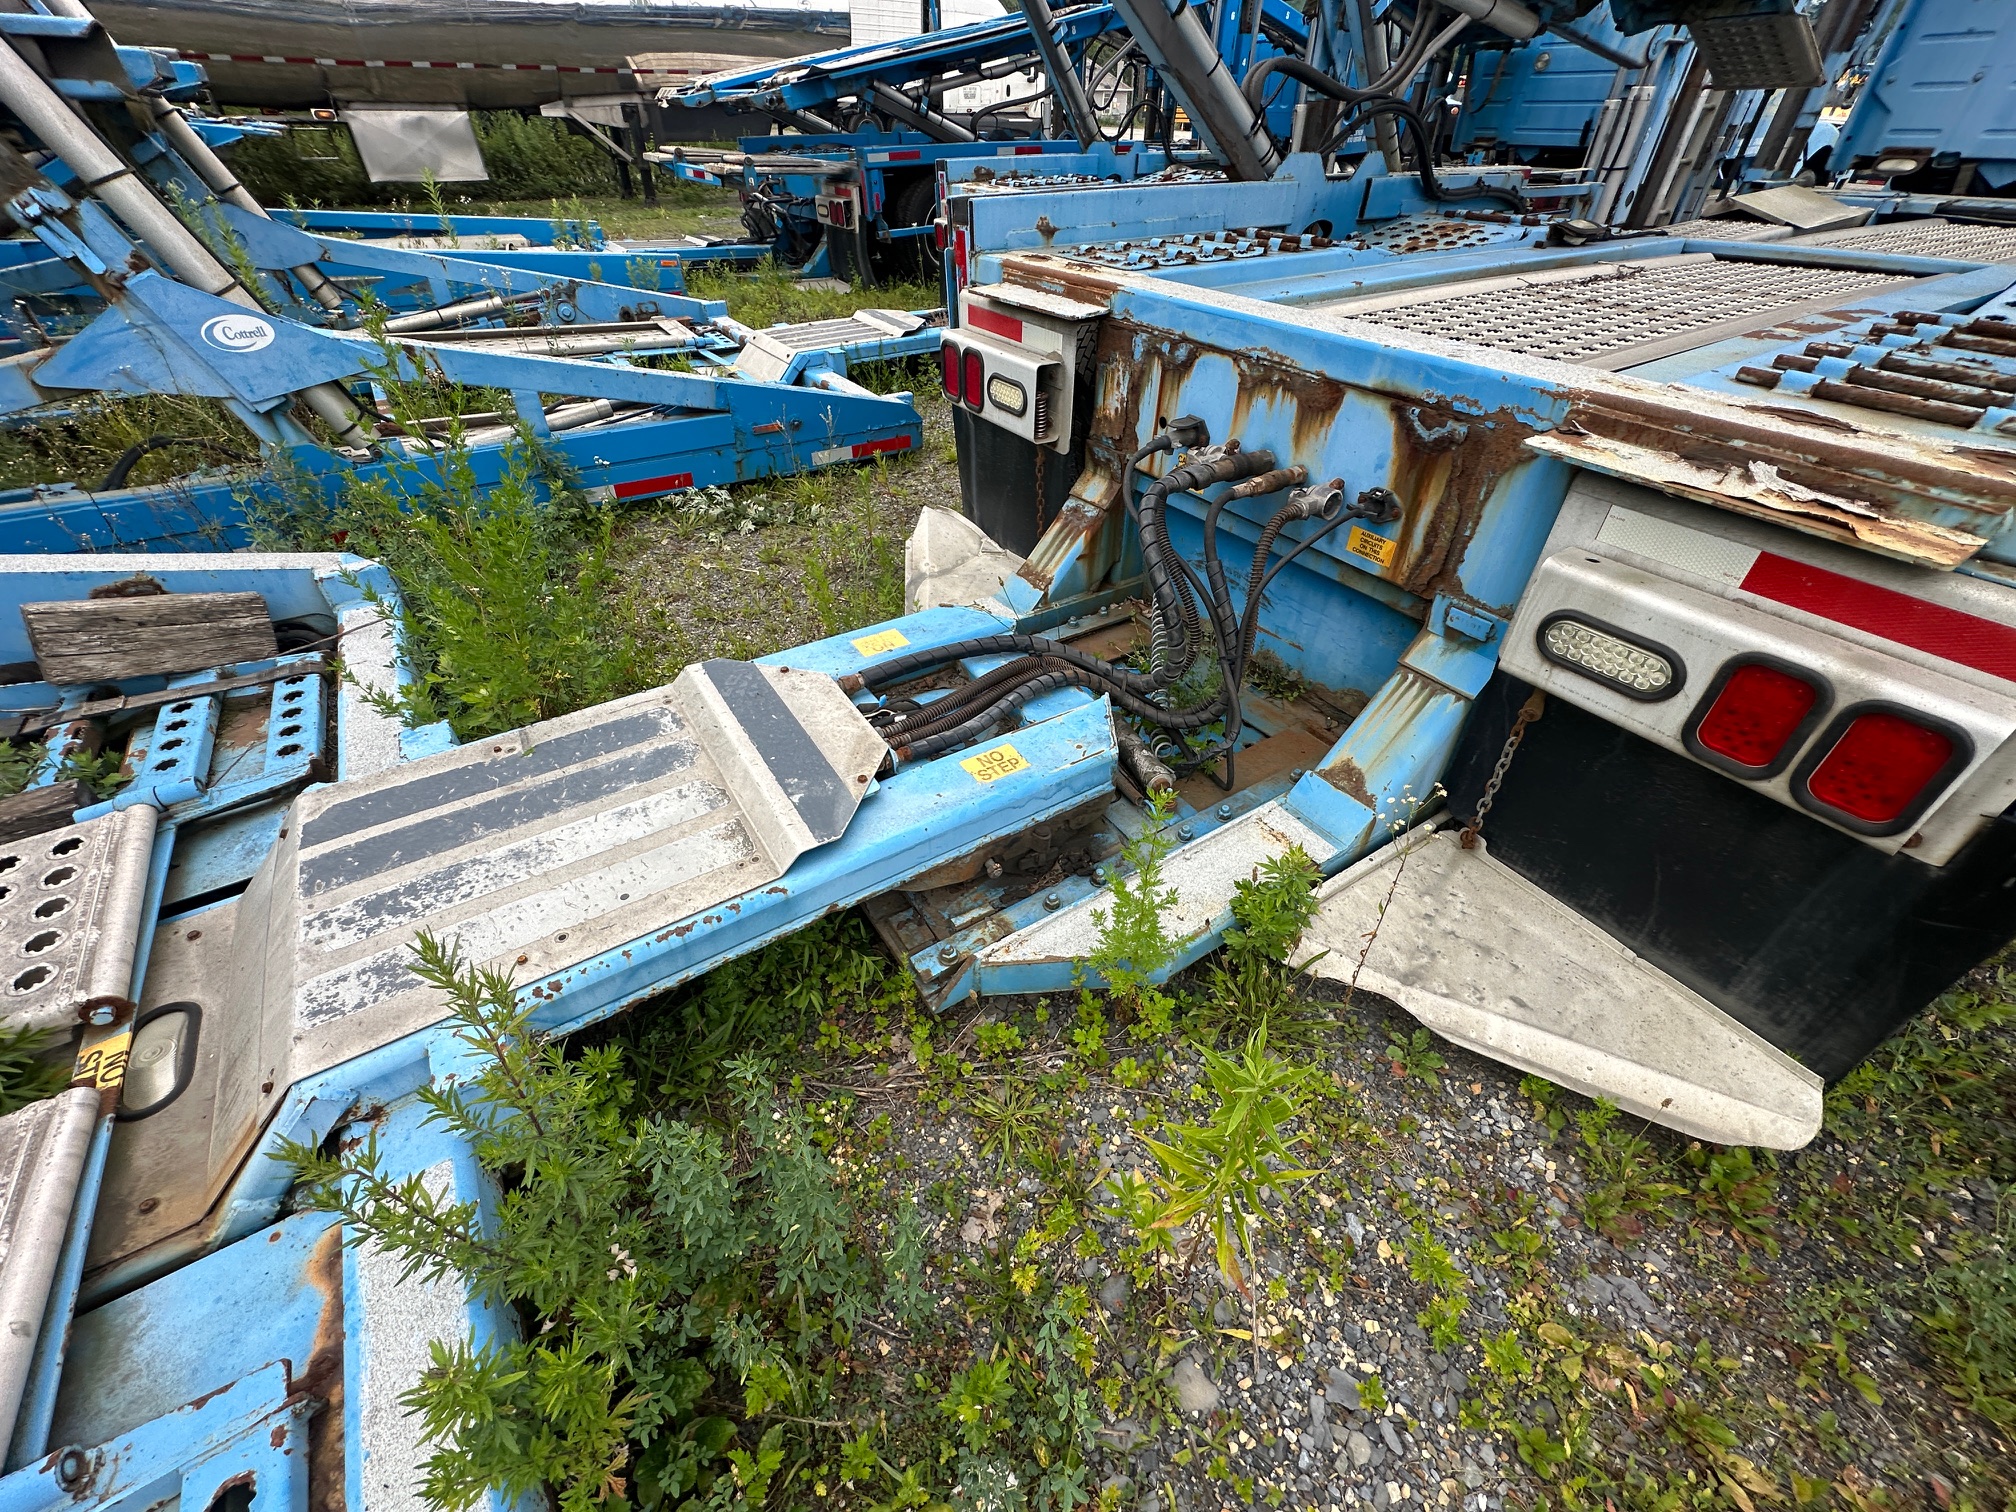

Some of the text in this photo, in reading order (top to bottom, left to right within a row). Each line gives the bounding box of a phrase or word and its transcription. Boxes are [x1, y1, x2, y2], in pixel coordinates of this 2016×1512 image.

[1071, 25, 1077, 35] 8
[748, 177, 755, 187] 9
[222, 325, 268, 341] Cottrell
[1359, 537, 1384, 550] CIRCUITS
[1360, 531, 1387, 544] AUXILIARY
[1352, 546, 1385, 564] CONNECTION
[1359, 543, 1381, 556] ON THIS
[976, 750, 1004, 768] NO
[977, 757, 1020, 781] STEP
[100, 1049, 130, 1083] NO
